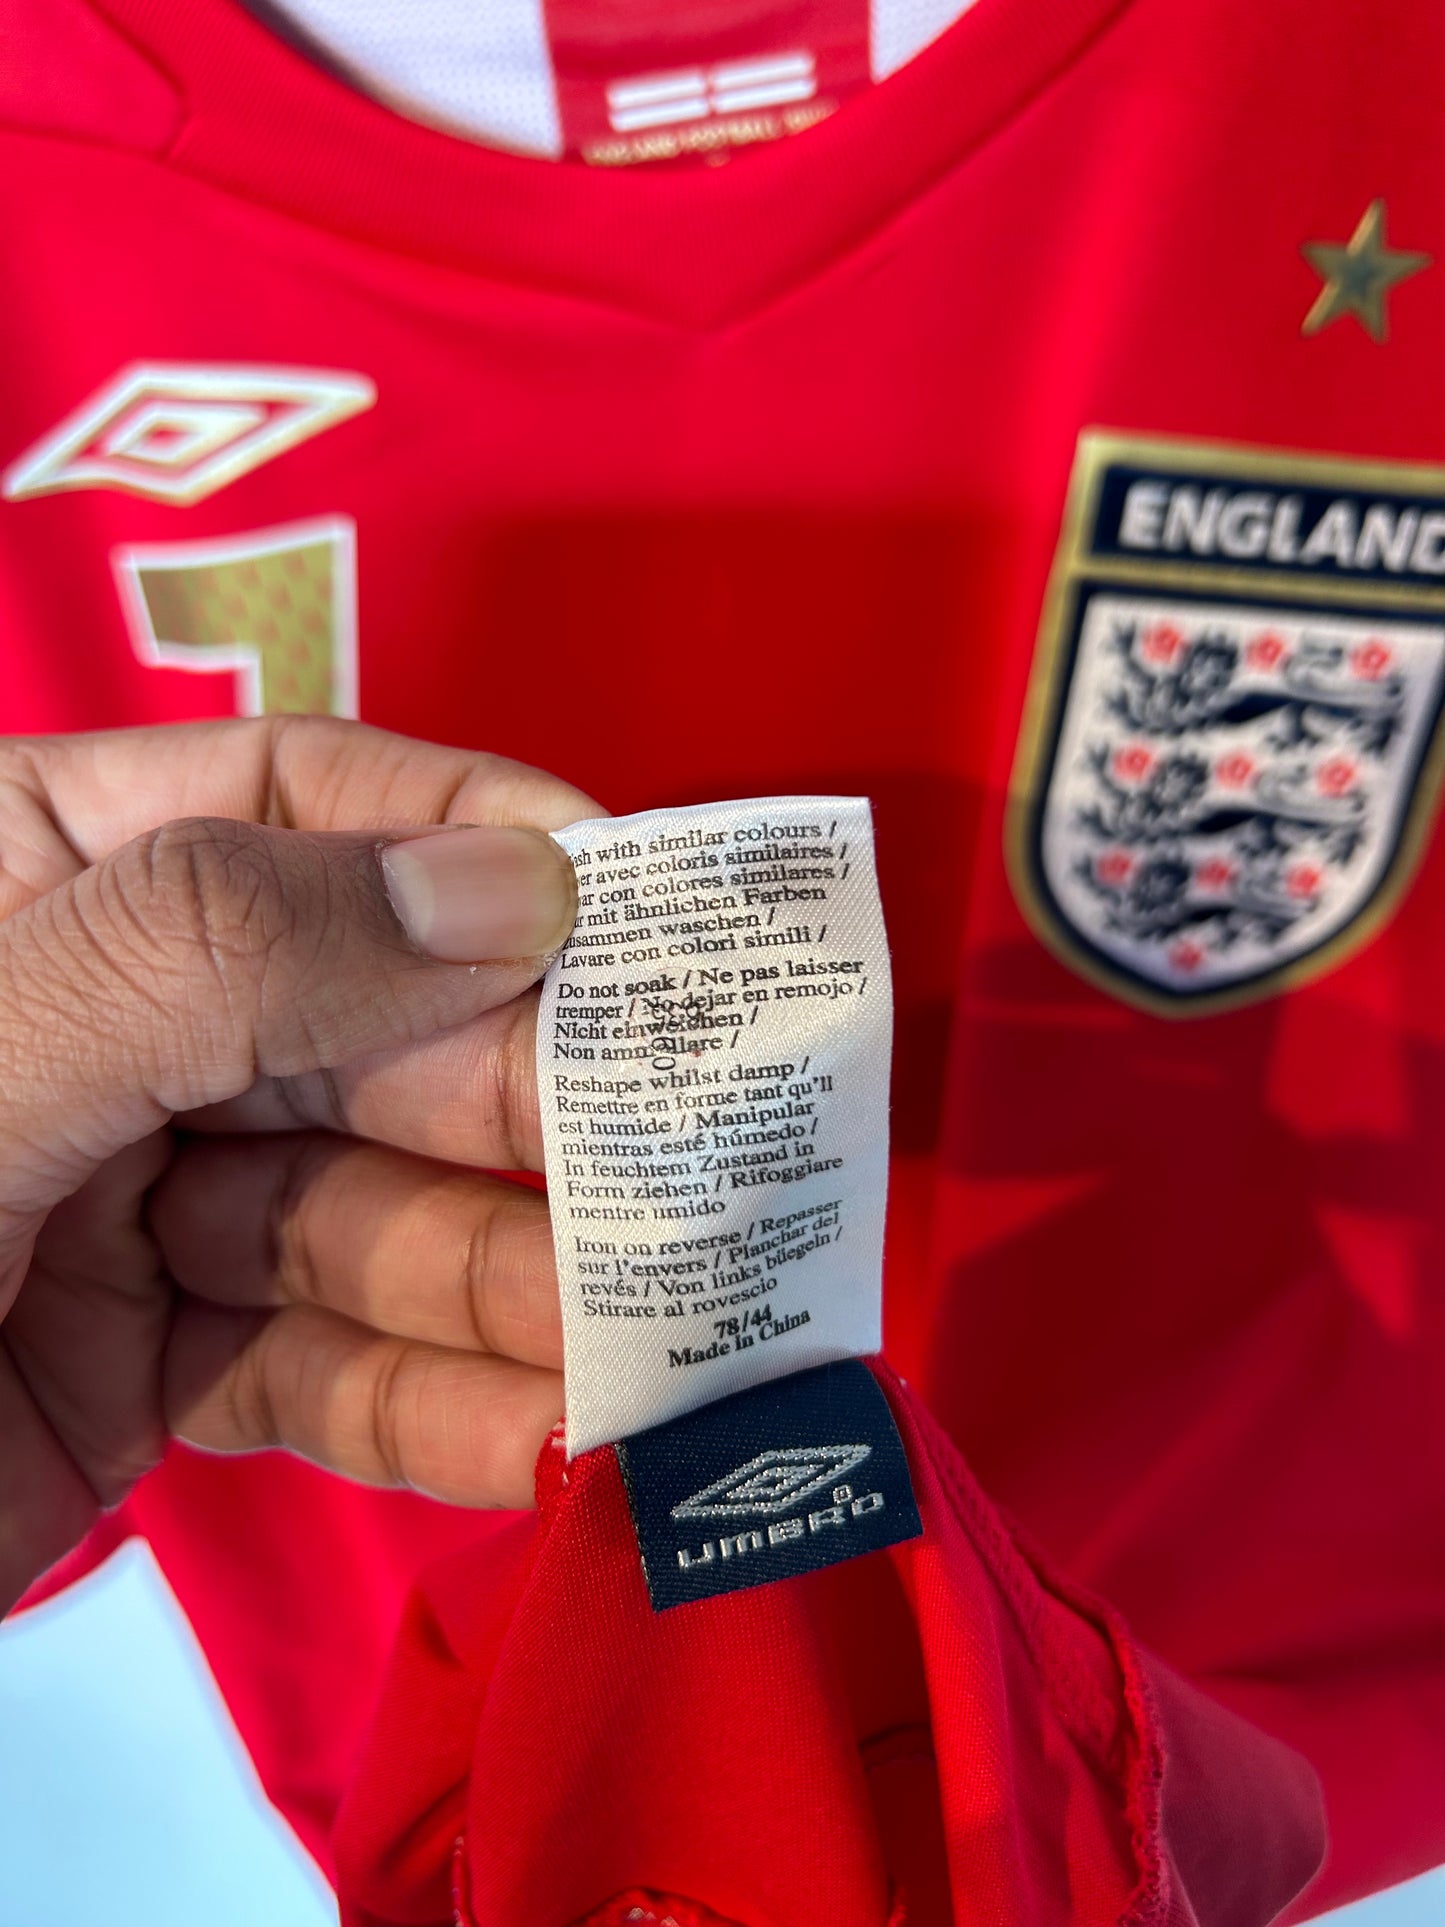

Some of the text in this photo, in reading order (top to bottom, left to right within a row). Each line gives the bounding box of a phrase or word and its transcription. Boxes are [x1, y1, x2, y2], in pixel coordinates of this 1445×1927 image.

[1118, 480, 1445, 574] ENGLAND
[596, 841, 642, 863] with
[649, 829, 728, 854] similar
[734, 822, 822, 842] colours
[829, 820, 837, 838] /
[596, 865, 641, 884] avec
[646, 851, 719, 875] coloris
[725, 842, 833, 865] similaires
[839, 842, 848, 859] /
[600, 887, 636, 904] con
[642, 875, 724, 897] colores
[730, 864, 835, 886] similares
[841, 863, 850, 880] /
[588, 908, 618, 926] mit
[624, 895, 737, 921] ähnlichen
[742, 885, 827, 906] Farben
[560, 924, 827, 969] Lavare con colori simili /
[562, 906, 776, 950] zusammen waschen /
[557, 958, 864, 999] Do not soak / Ne pas laisser
[556, 1004, 624, 1023] tremper
[628, 997, 636, 1018] /
[680, 989, 737, 1011] dejar
[742, 988, 769, 1003] en
[774, 978, 853, 999] remojo
[858, 977, 867, 995] /
[553, 1005, 759, 1039] Nicht einweichen /
[553, 1043, 596, 1059] Non
[730, 1029, 739, 1049] /
[553, 1055, 810, 1098] Reshape whilst damp /
[556, 1096, 639, 1114] Remettre
[645, 1098, 670, 1113] en
[675, 1089, 738, 1109] forme
[744, 1084, 783, 1101] tant
[558, 1102, 815, 1135] est humide / Manipular
[561, 1117, 818, 1157] mientras esté húmedo /
[564, 1141, 815, 1177] In feuchtem Zustand in
[566, 1157, 843, 1199] Form ziehen / Rifoggiare
[569, 1199, 726, 1220] mentre umido
[574, 1199, 843, 1255] Iron on reverse / Repasser
[578, 1212, 839, 1277] sur l'envers / Planchar del
[580, 1225, 843, 1297] revés / Von links büegeln /
[583, 1277, 778, 1317] Stirare al rovescio
[667, 1341, 730, 1368] Made
[759, 1310, 811, 1341] China
[713, 1303, 772, 1339] 78/44
